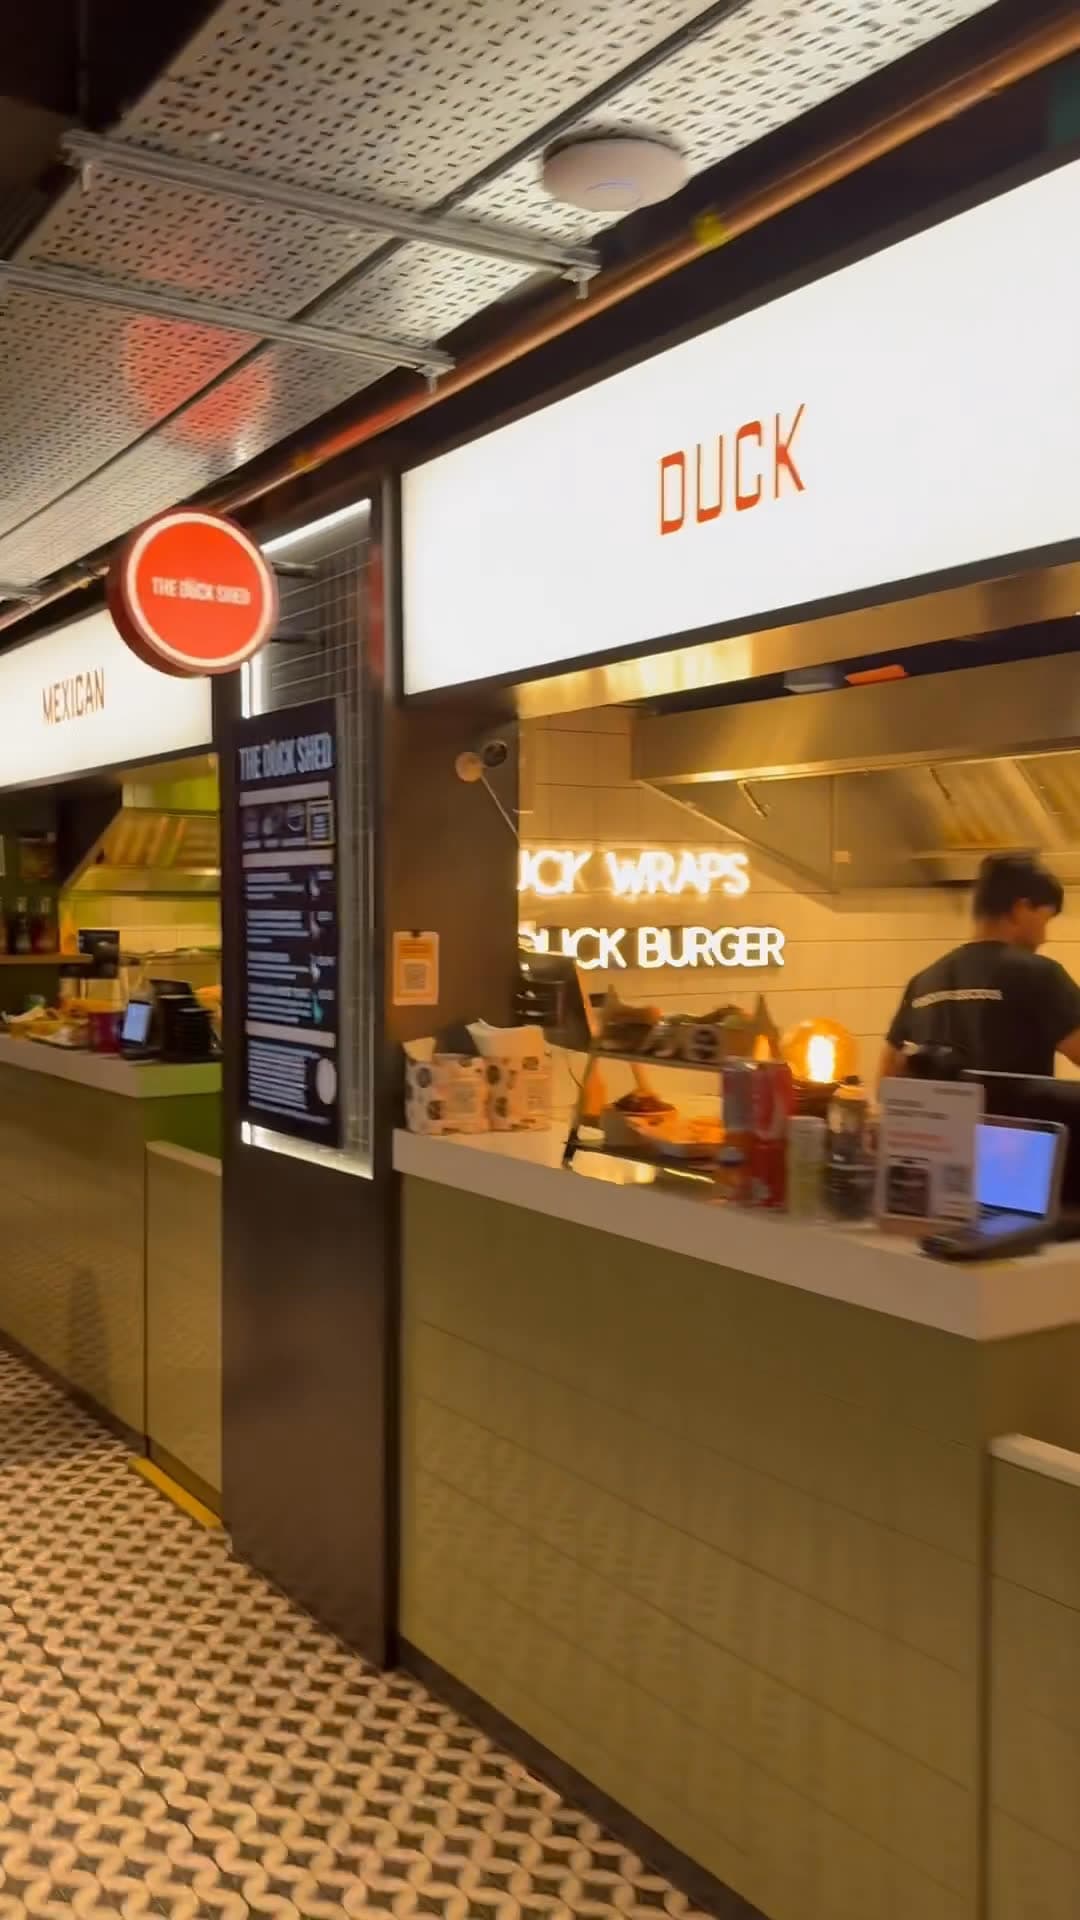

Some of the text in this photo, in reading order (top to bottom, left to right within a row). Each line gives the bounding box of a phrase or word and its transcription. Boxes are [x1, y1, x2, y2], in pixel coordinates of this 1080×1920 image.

[660, 403, 806, 536] DUCK
[152, 576, 177, 598] THE
[41, 666, 105, 725] MEXICAN
[239, 745, 262, 781] THE
[296, 732, 333, 773] SHED
[603, 850, 750, 898] WRAPS
[637, 926, 785, 969] BURGER
